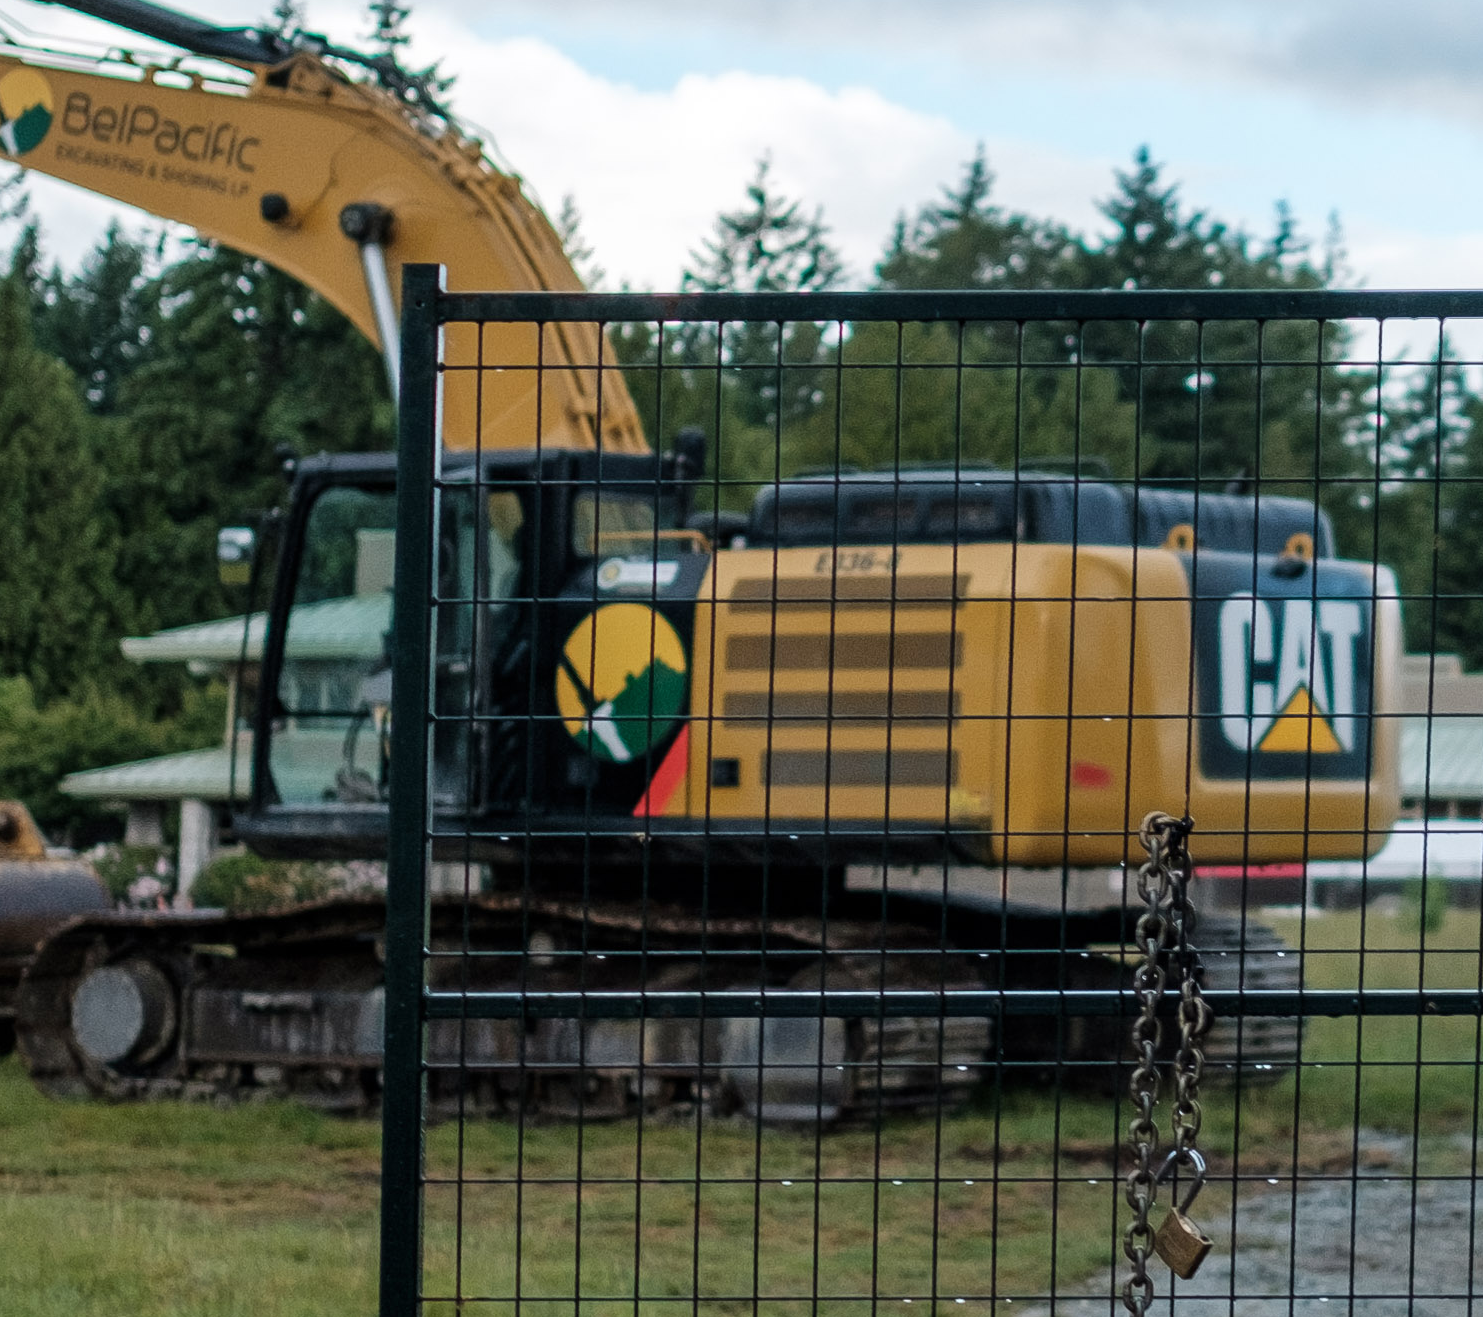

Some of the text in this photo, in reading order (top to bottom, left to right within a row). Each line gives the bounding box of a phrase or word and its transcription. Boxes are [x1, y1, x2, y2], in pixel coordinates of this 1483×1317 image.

[55, 143, 144, 177] EXCAVATING
[148, 161, 157, 179] &
[61, 91, 263, 173] BelPacific
[1218, 592, 1361, 753] CAT
